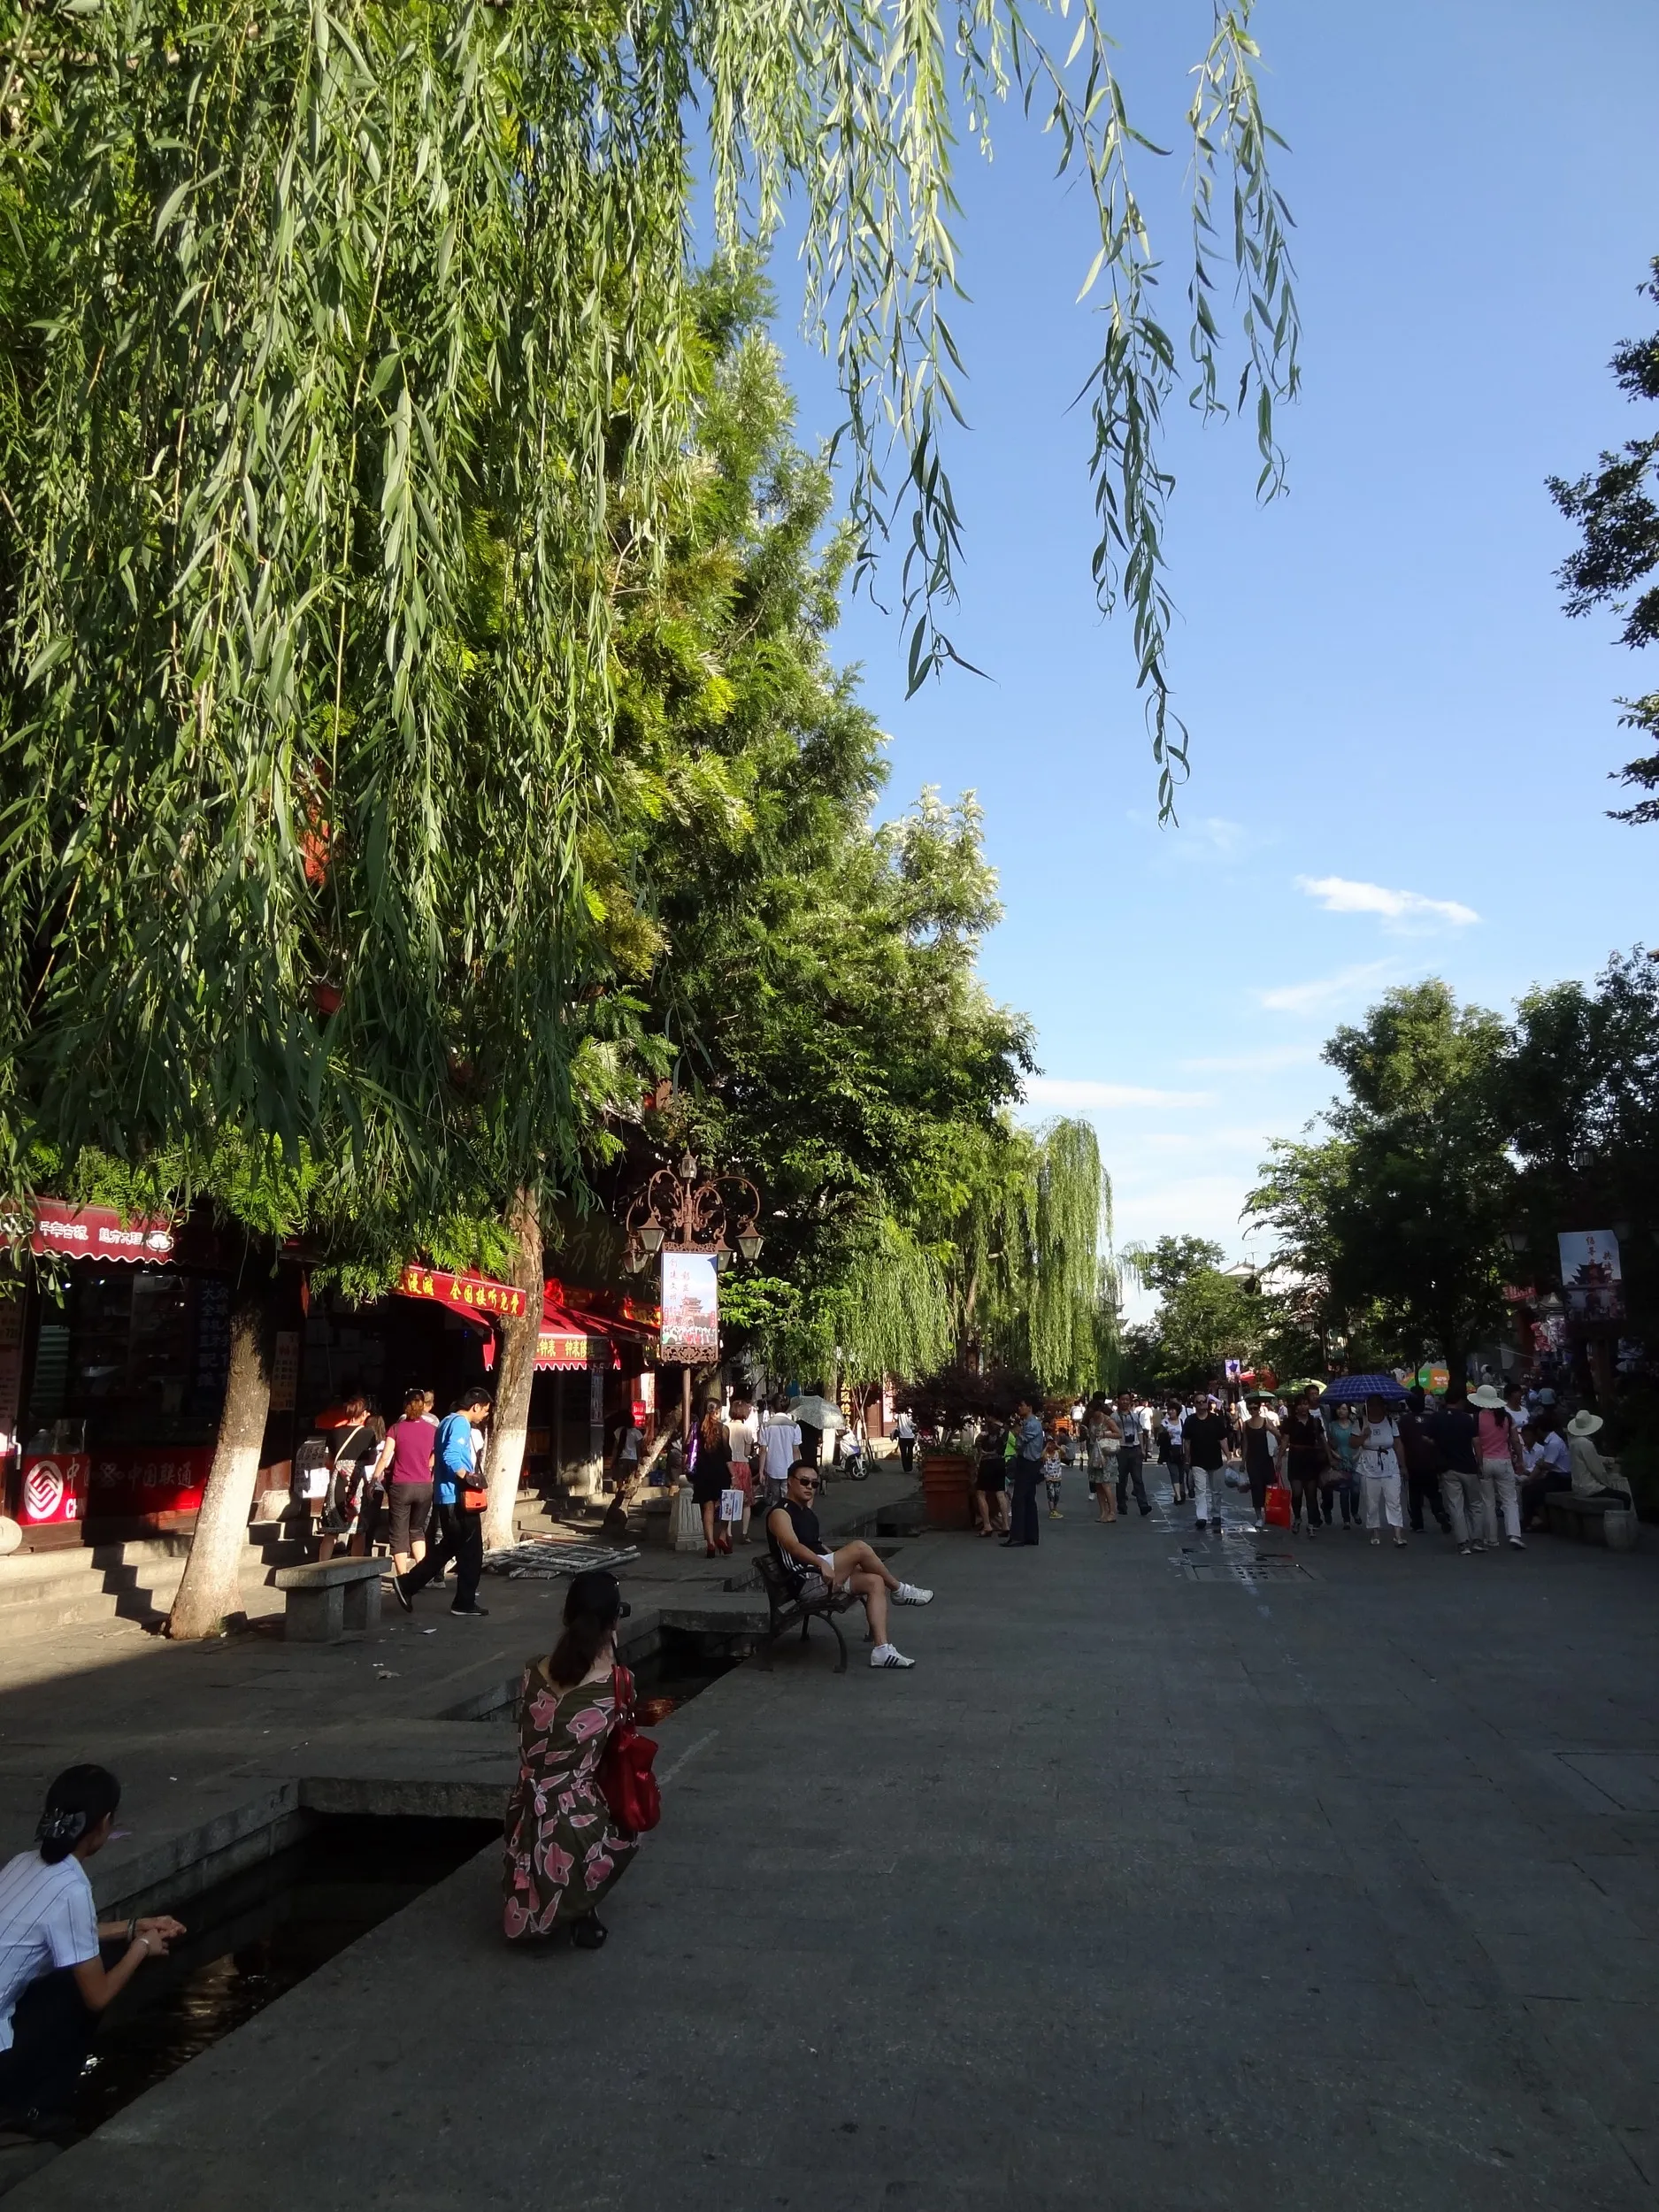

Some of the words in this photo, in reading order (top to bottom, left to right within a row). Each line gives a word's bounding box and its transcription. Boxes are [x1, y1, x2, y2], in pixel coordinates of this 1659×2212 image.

[449, 1279, 519, 1315] 全国接听免费
[535, 1338, 557, 1358] 钟表
[127, 1461, 195, 1492] 中国联通
